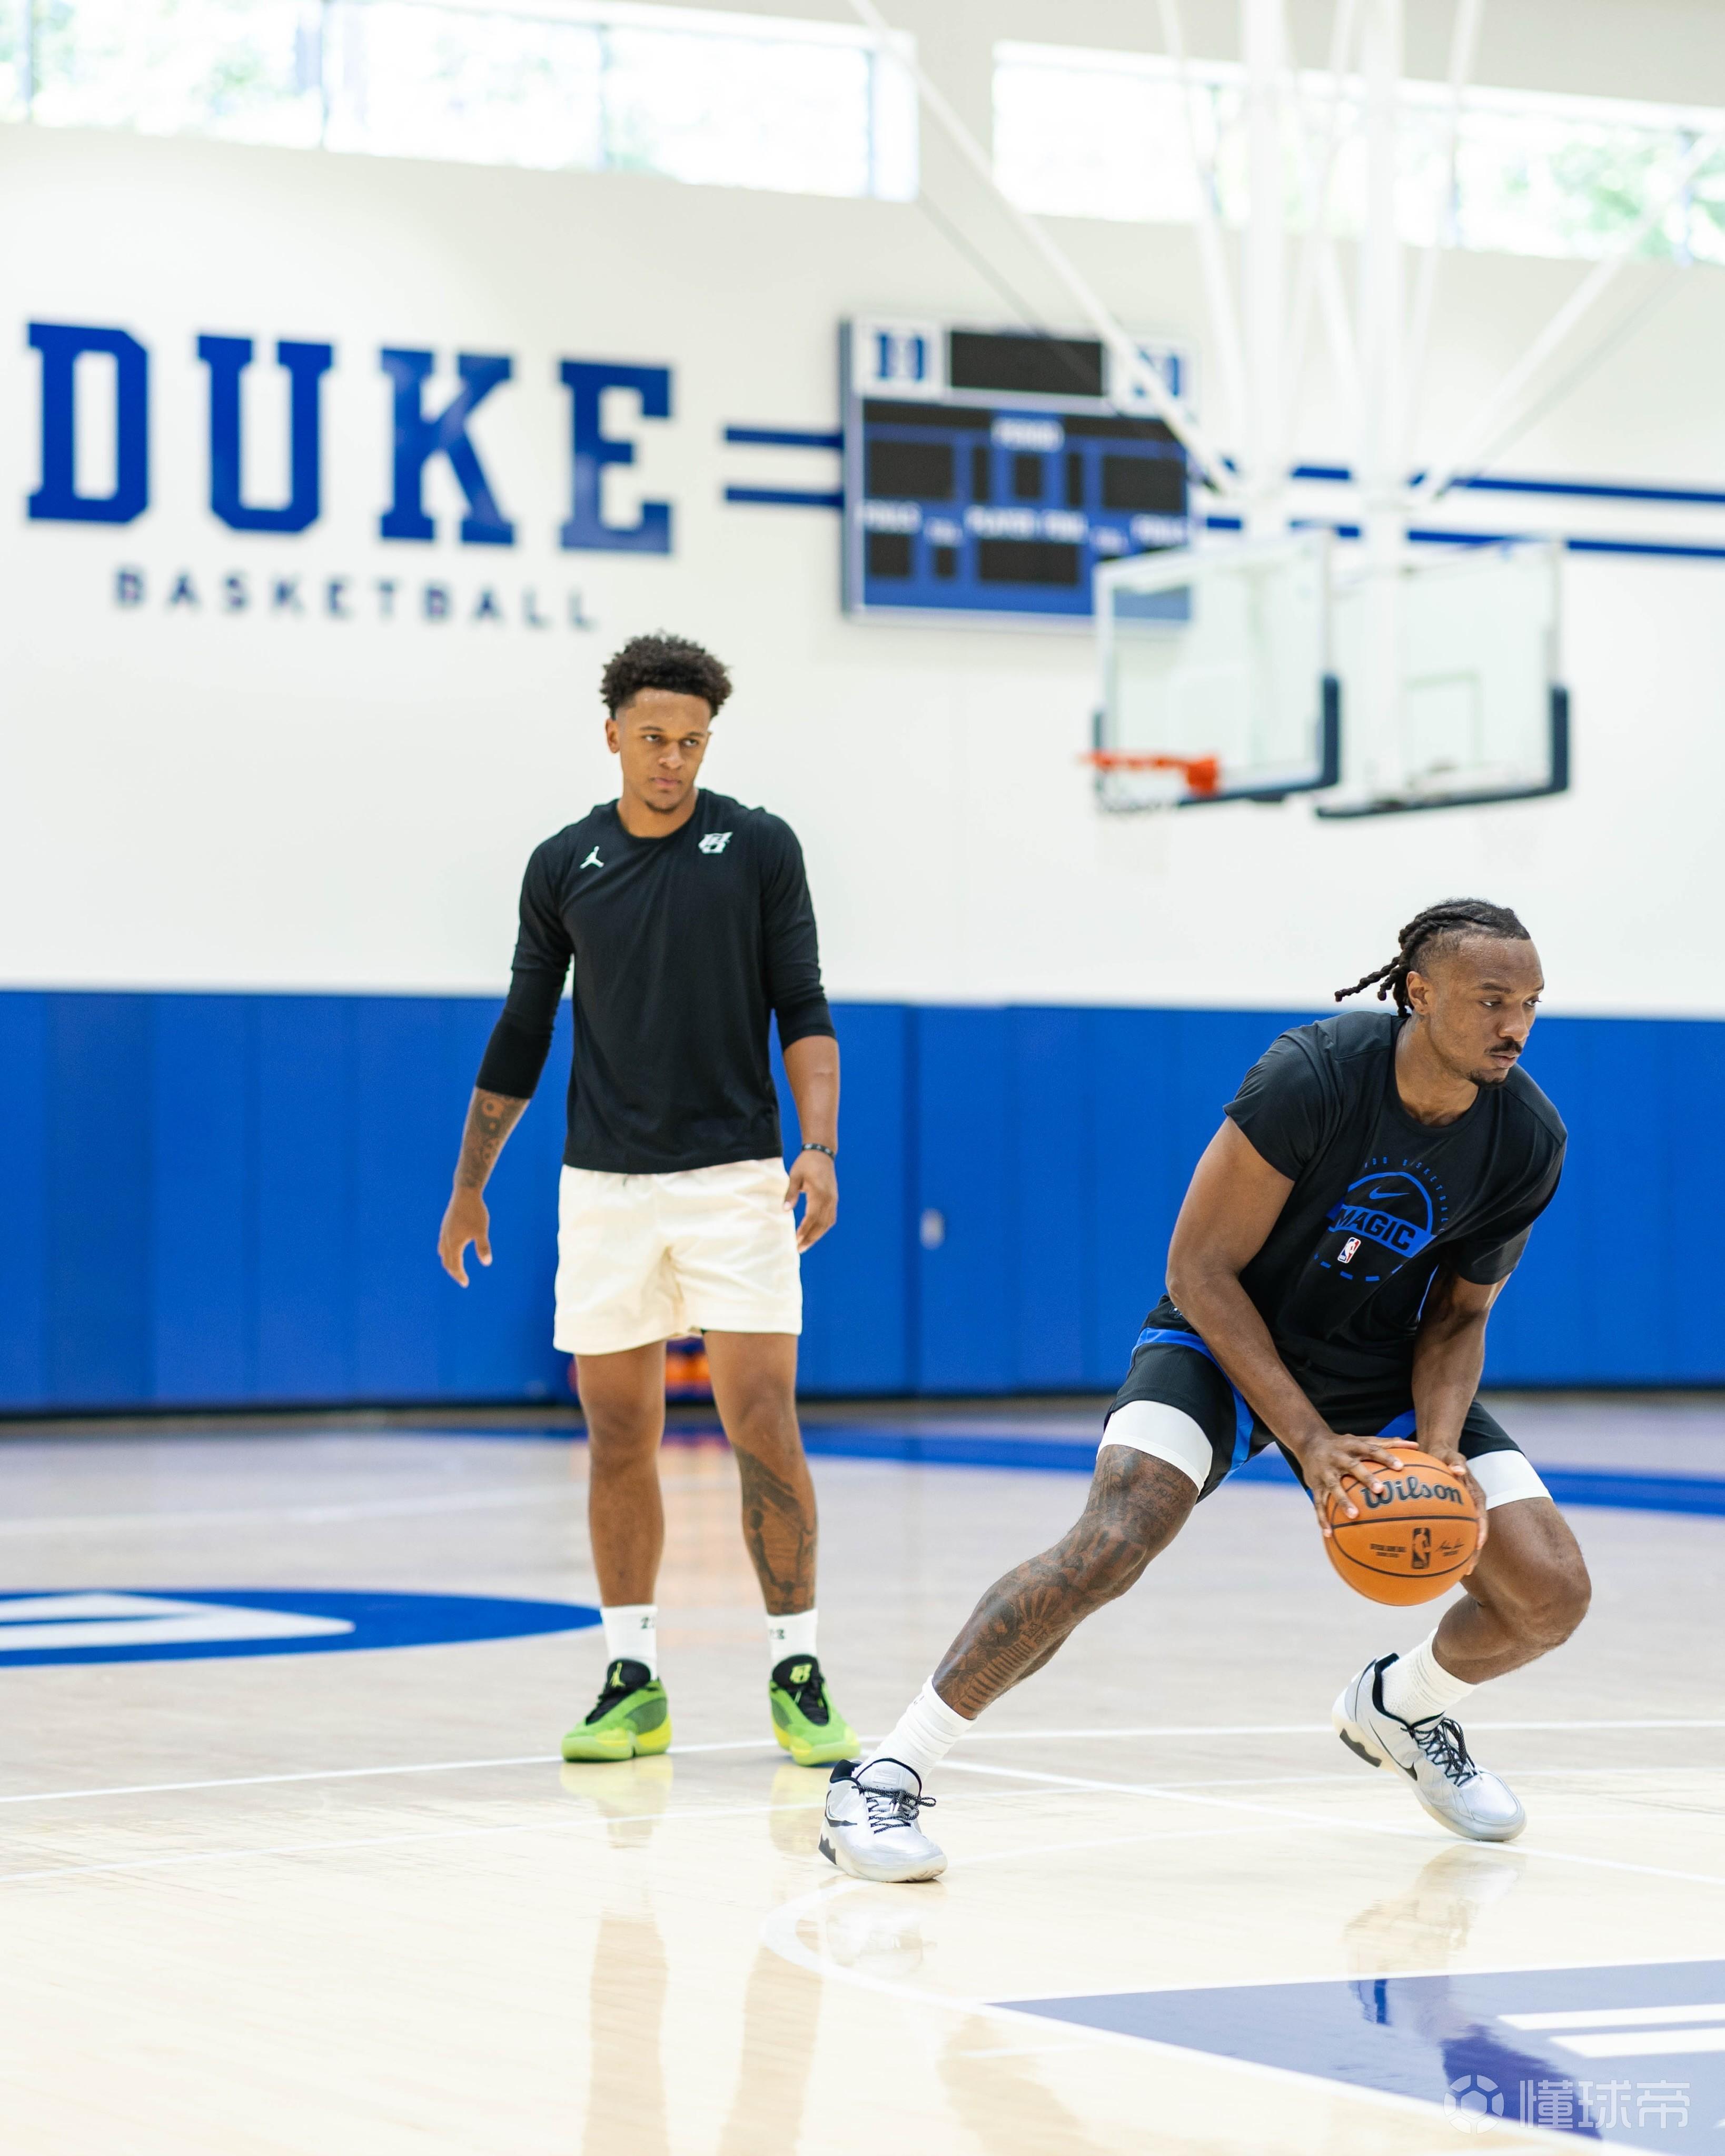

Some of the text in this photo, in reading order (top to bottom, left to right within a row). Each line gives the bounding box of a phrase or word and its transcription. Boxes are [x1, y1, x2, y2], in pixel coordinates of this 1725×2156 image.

[28, 322, 672, 557] DUKE
[116, 567, 595, 629] BASKETBALL
[1333, 1208, 1416, 1251] MAGIC
[1360, 1476, 1464, 1509] Wilson
